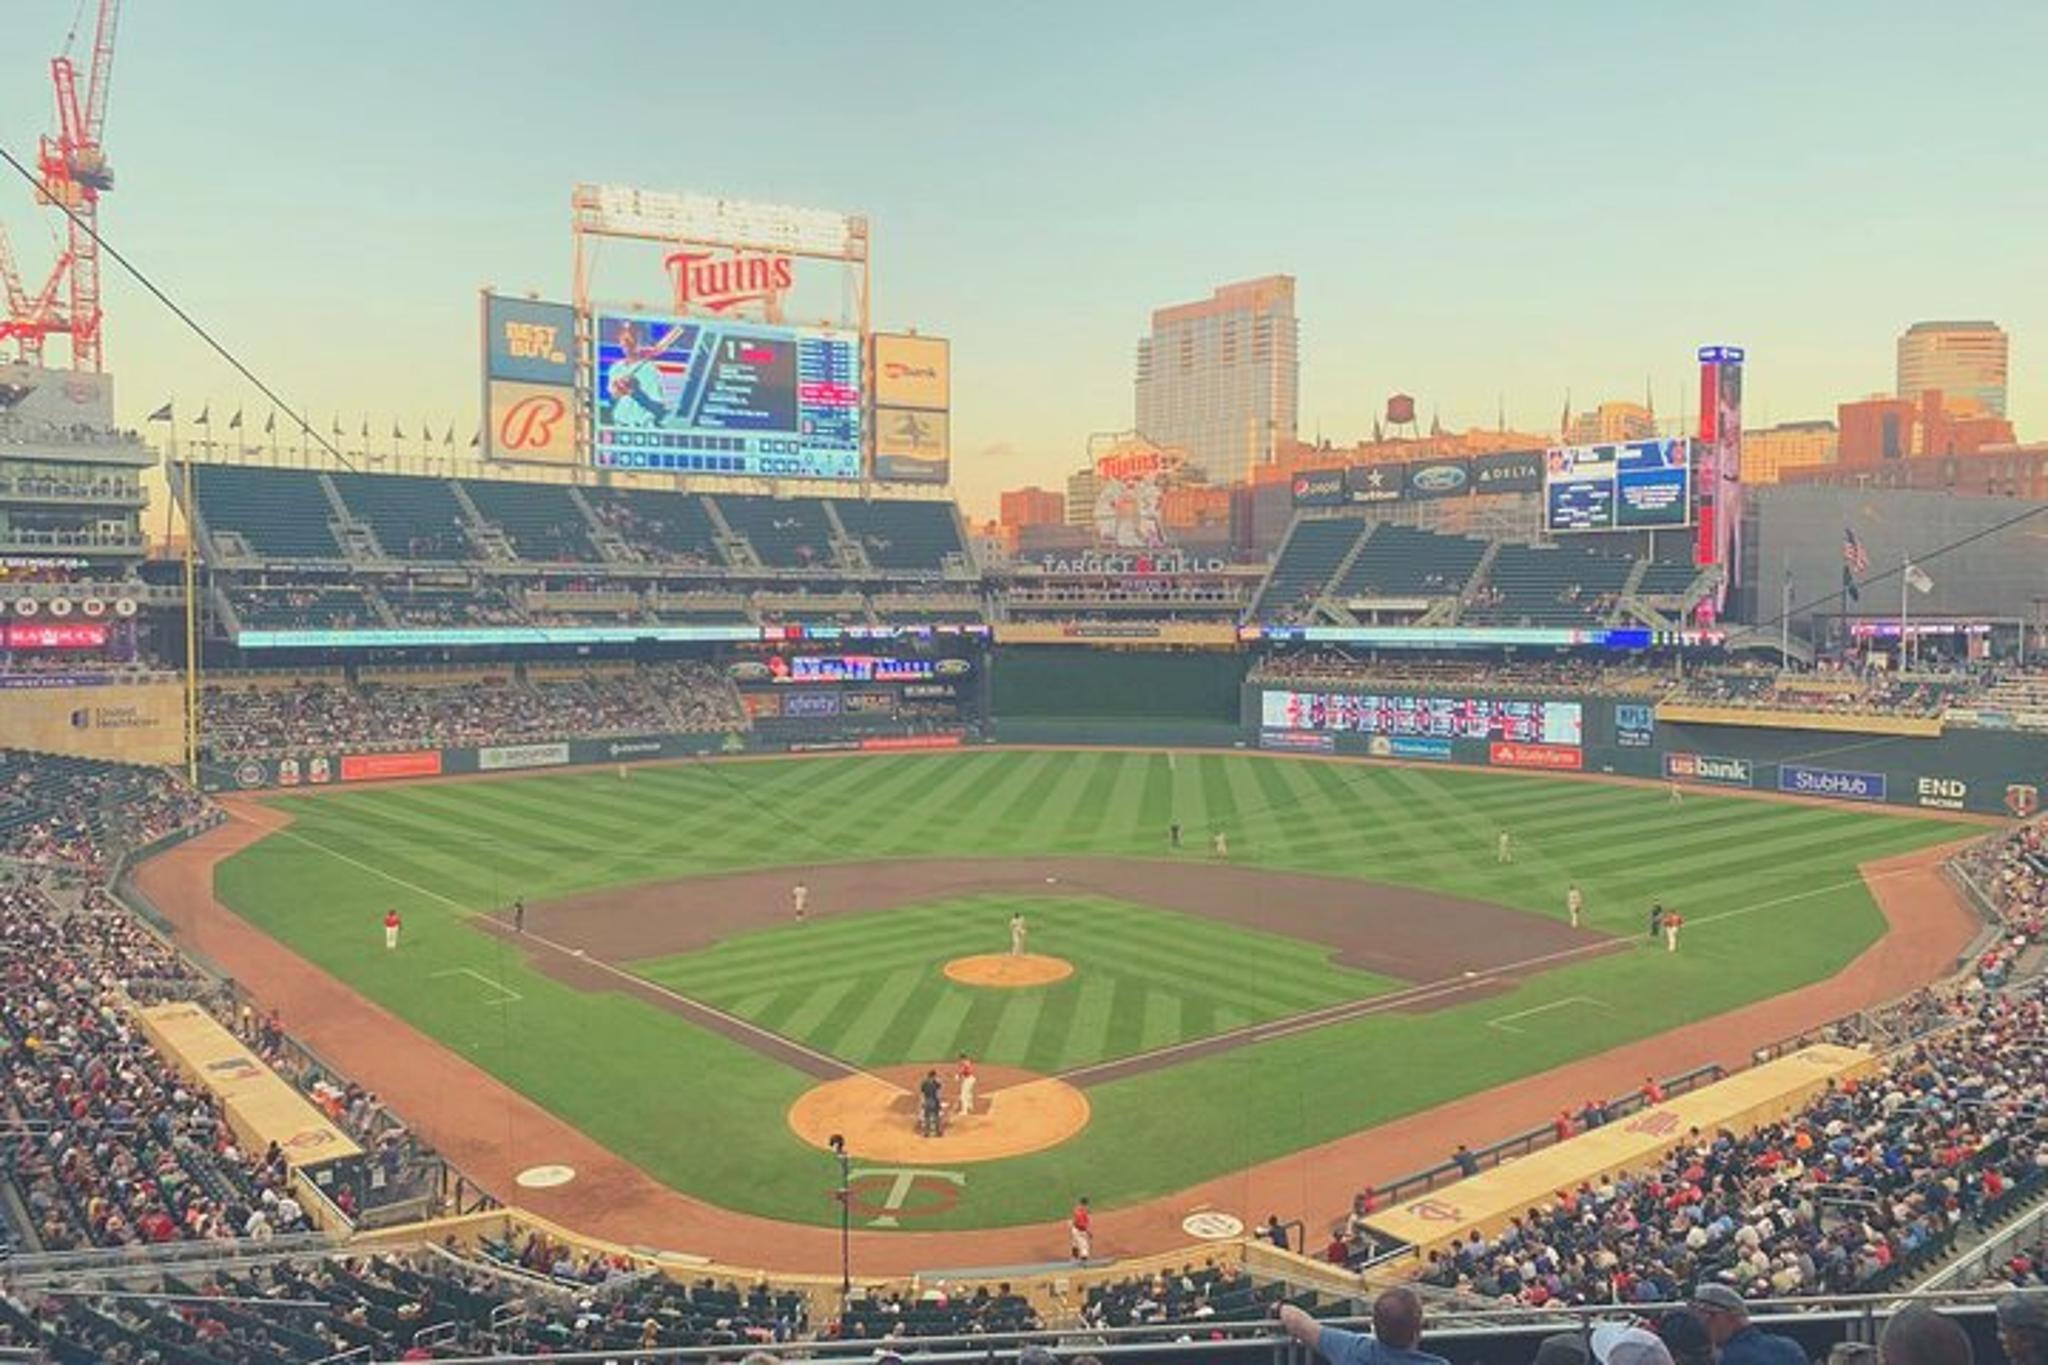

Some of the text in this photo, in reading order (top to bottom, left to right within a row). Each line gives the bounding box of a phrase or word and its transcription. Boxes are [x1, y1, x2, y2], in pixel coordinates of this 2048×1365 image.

[665, 252, 792, 308] Twins
[505, 320, 558, 344] BEST
[501, 394, 565, 450] B
[1493, 466, 1537, 479] DELTA
[1043, 556, 1133, 573] TARGET
[1156, 556, 1225, 573] FIELD
[1795, 772, 1867, 794] StubHub
[1919, 778, 1966, 797] END
